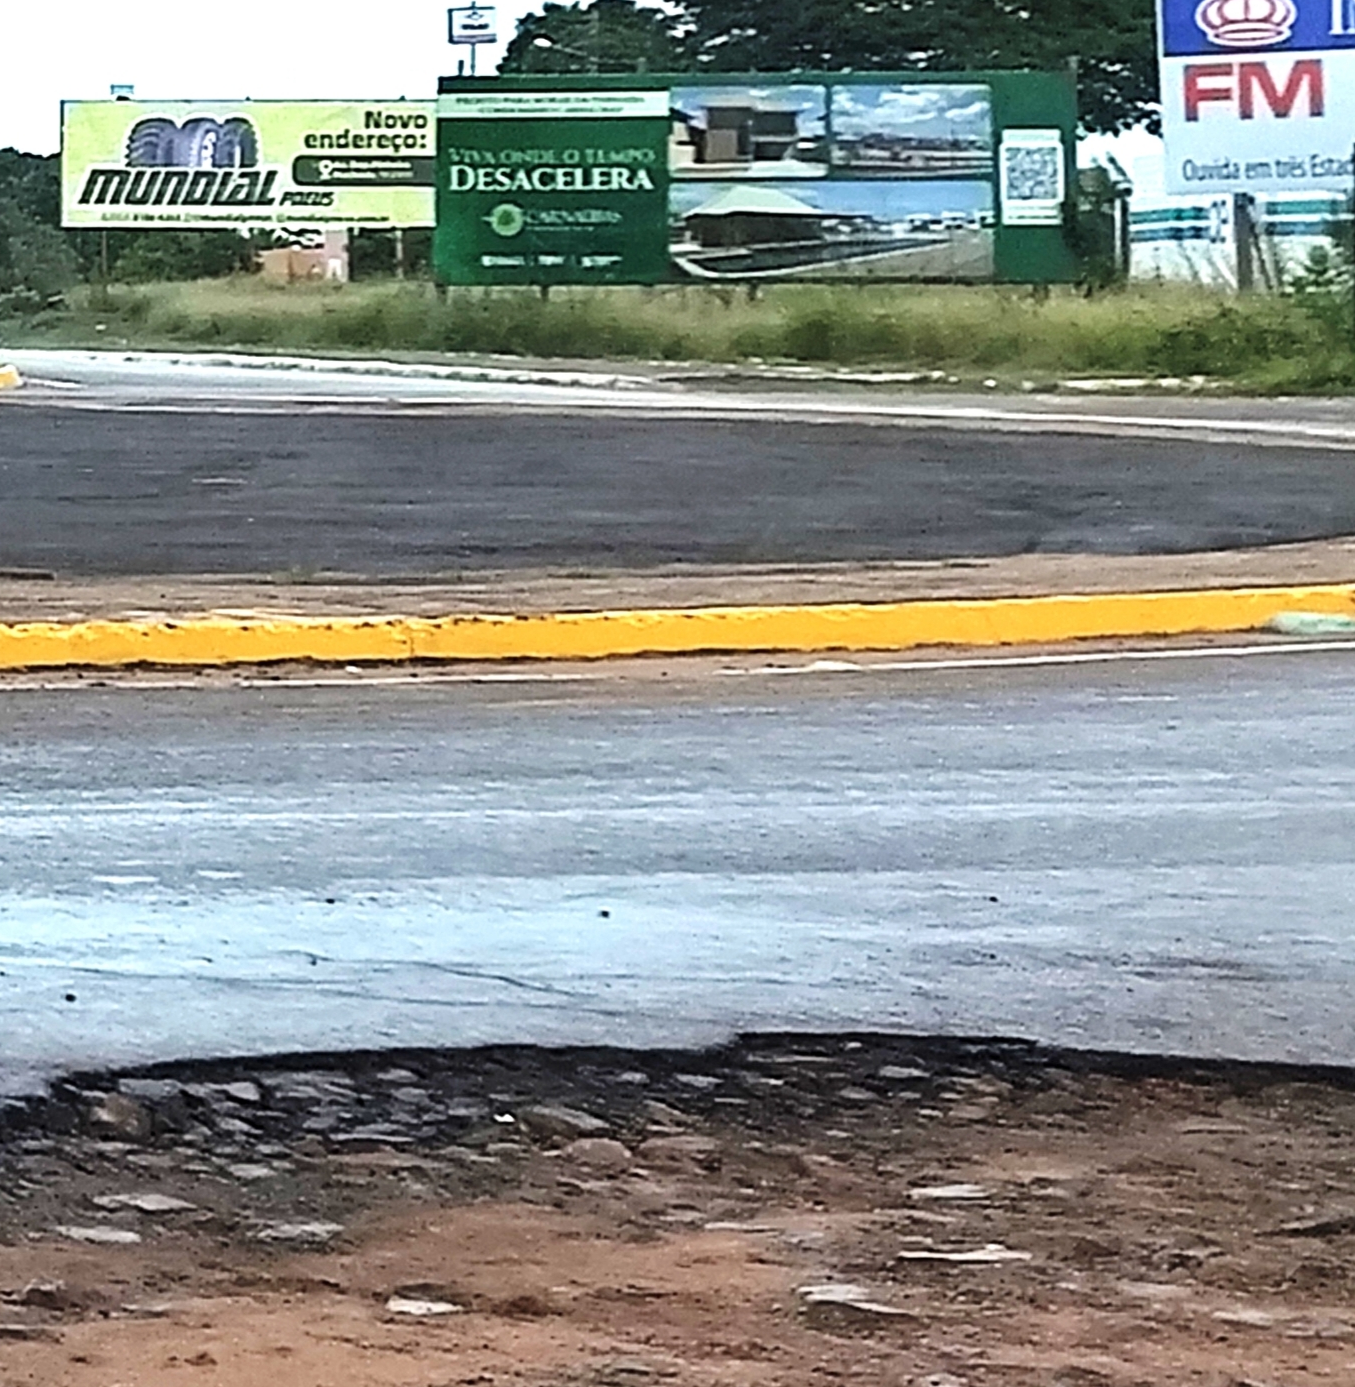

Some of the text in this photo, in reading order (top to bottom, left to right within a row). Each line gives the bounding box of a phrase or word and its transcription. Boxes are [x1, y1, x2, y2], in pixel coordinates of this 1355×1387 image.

[1184, 59, 1324, 122] FM
[364, 110, 428, 129] Novo
[304, 128, 427, 153] endereço:
[562, 149, 580, 164] O
[449, 165, 655, 191] DESACELERA
[1183, 157, 1240, 182] Ouvida
[1245, 162, 1272, 179] em
[78, 169, 280, 206] MUNDIAL
